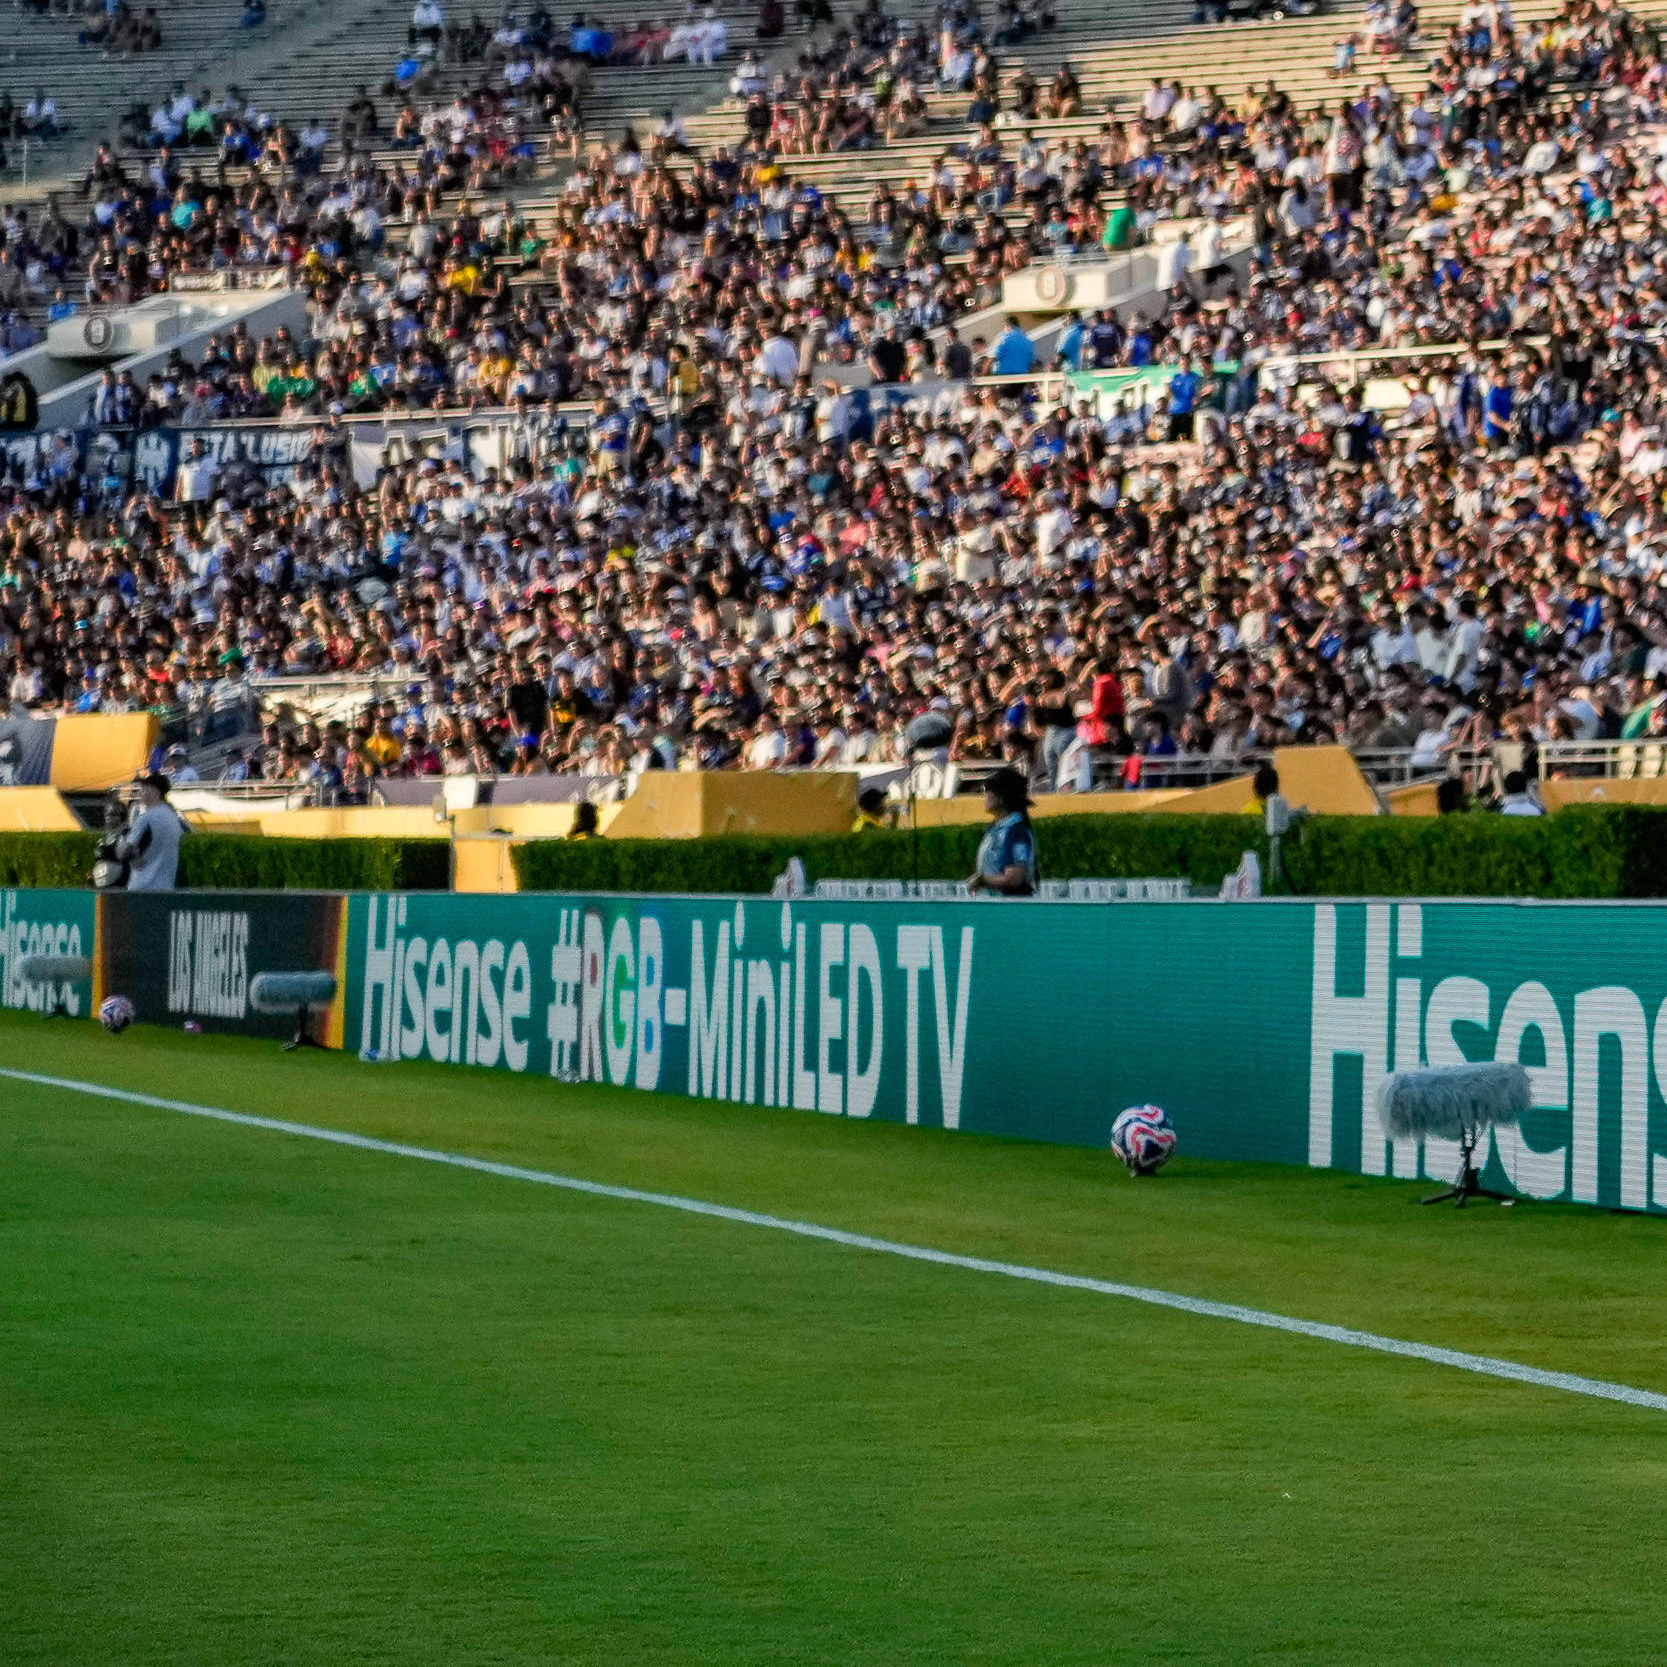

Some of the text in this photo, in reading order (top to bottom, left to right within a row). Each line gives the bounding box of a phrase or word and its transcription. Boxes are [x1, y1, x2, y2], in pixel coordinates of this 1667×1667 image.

[168, 911, 249, 1019] LOS ANGELES
[359, 895, 975, 1129] Hisense #RGB-MiniLED TV
